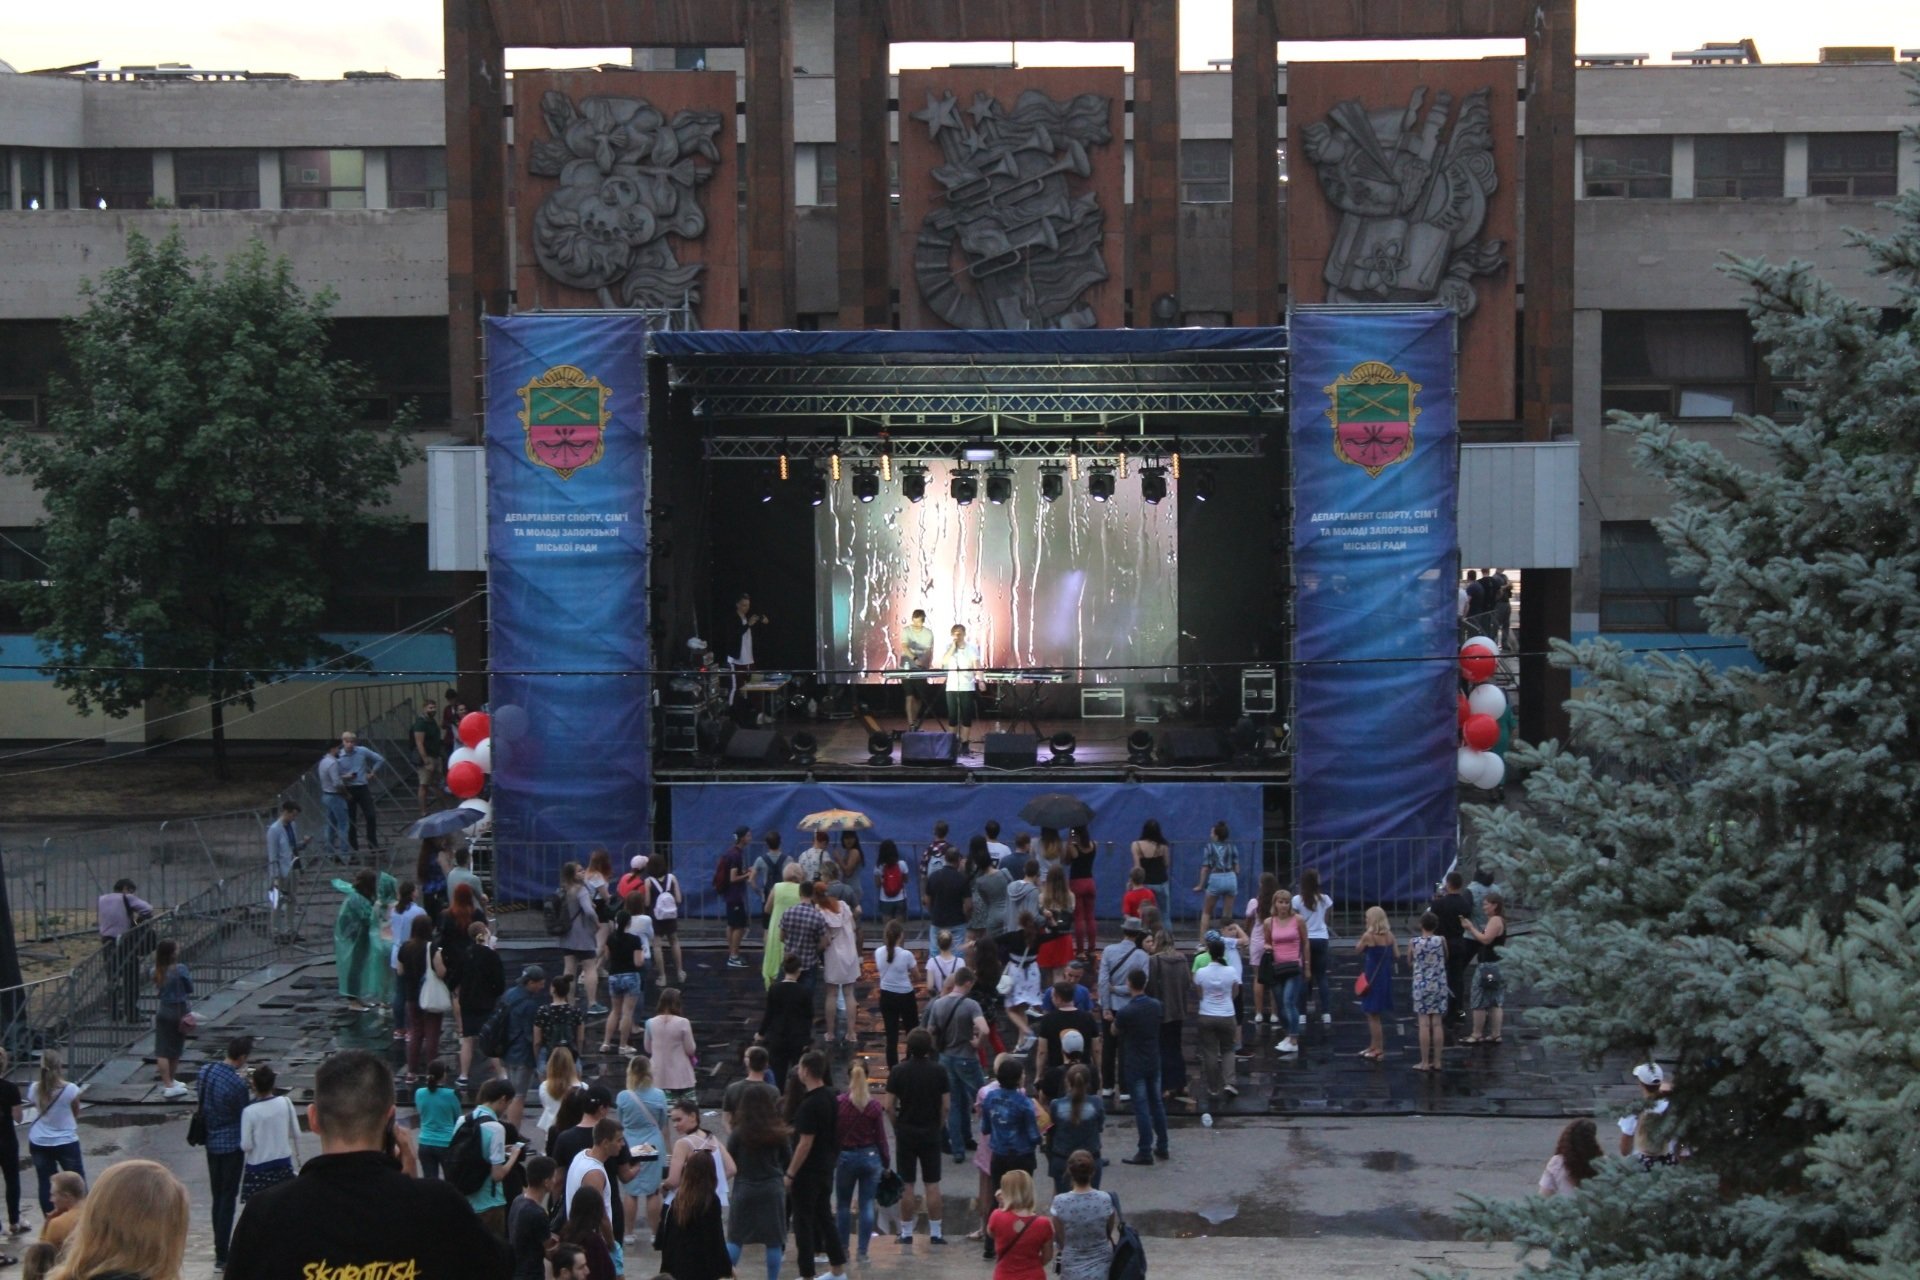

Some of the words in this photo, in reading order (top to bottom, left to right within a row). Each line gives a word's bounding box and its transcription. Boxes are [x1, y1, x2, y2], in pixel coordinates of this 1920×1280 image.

[504, 513, 565, 522] ДЕПАРТАМЕНТ
[1311, 512, 1373, 522] ДЕПАРТАМЕНТ
[514, 528, 525, 537] ТА
[526, 528, 560, 538] МОЛОДІ
[562, 527, 619, 537] ЗАПОРІЗЬКОЇ
[1320, 528, 1331, 536] ТА
[1333, 527, 1367, 536] МОЛОДІ
[1369, 524, 1428, 535] ЗАПОРІЗЬКОЇ
[535, 542, 573, 551] МІСЬКОЇ
[574, 543, 598, 552] РАДИ
[1343, 541, 1381, 550] МІСЬКОЇ
[1383, 541, 1407, 550] РАДИ
